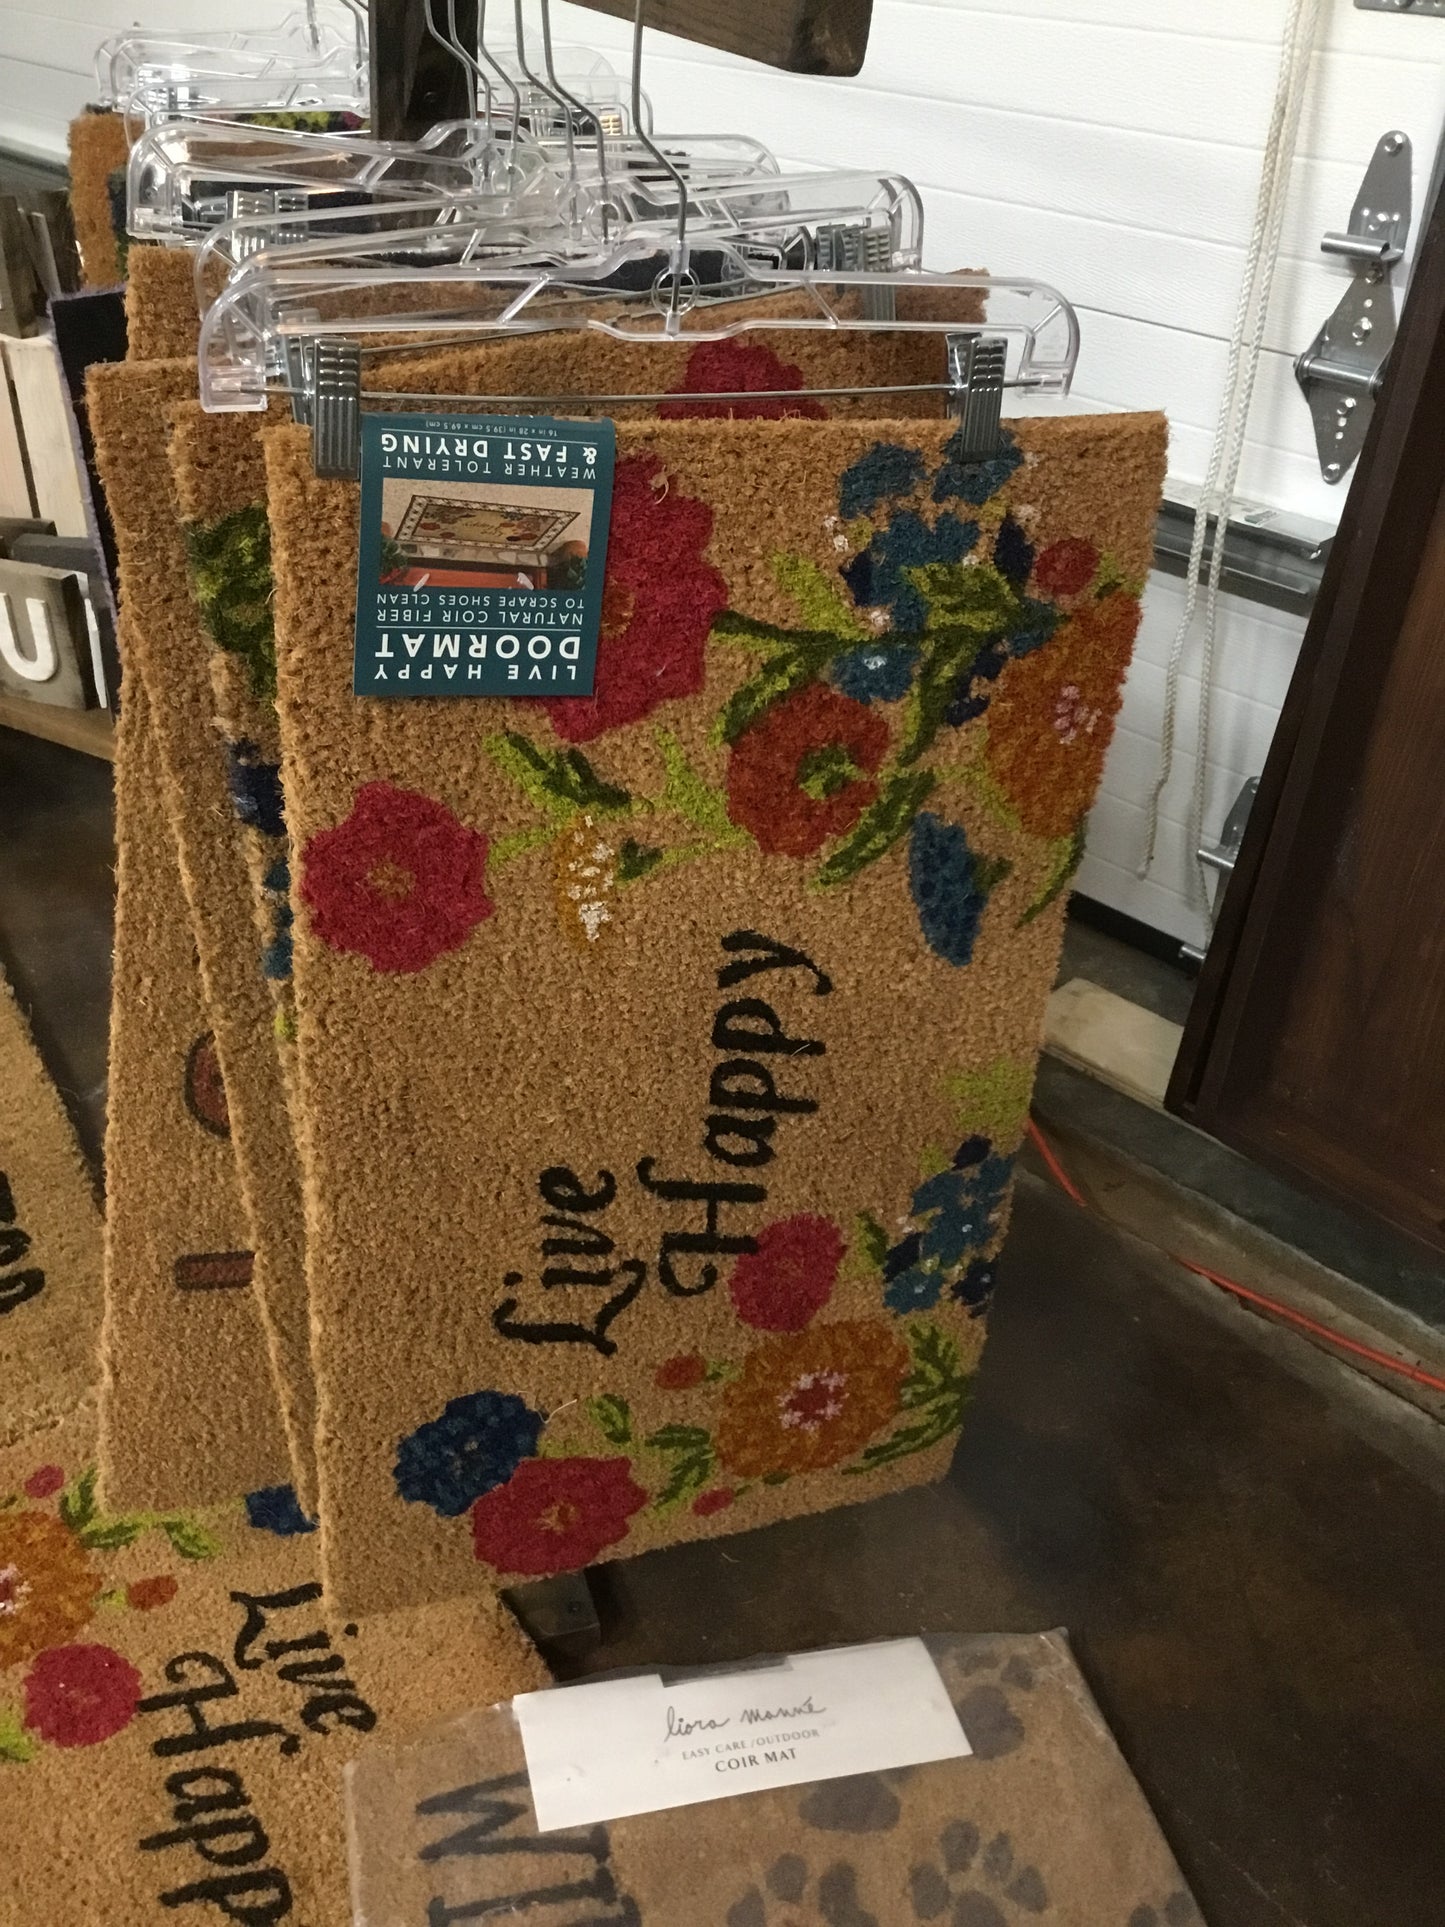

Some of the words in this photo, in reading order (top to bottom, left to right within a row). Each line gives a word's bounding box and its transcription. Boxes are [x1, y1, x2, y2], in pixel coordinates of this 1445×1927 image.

[443, 422, 462, 430] 69.5
[485, 424, 507, 434] (39.5
[518, 427, 529, 435] 28
[548, 429, 558, 437] 16
[381, 433, 489, 458] DRYING
[503, 442, 567, 463] FAST
[382, 455, 492, 474] TOLERANT
[582, 447, 598, 465] &
[503, 462, 597, 480] WEATHER
[376, 593, 431, 606] CLEAN
[438, 594, 491, 607] SHOES
[498, 596, 557, 609] SCRAPE
[564, 598, 585, 609] TO
[376, 609, 431, 623] FIBER
[442, 609, 489, 623] COIR
[498, 610, 583, 626] NATURAL
[374, 632, 581, 660] DOORMAT
[374, 663, 482, 680] HAPPY
[507, 664, 577, 681] LIVE
[636, 929, 833, 1297] Happy
[492, 1165, 646, 1357] Live
[230, 1582, 378, 1734] Live
[681, 1746, 711, 1761] EASY
[714, 1739, 747, 1754] CARE
[714, 1753, 760, 1773] COIR
[764, 1747, 798, 1764] MAT
[137, 1651, 301, 1927] Happ
